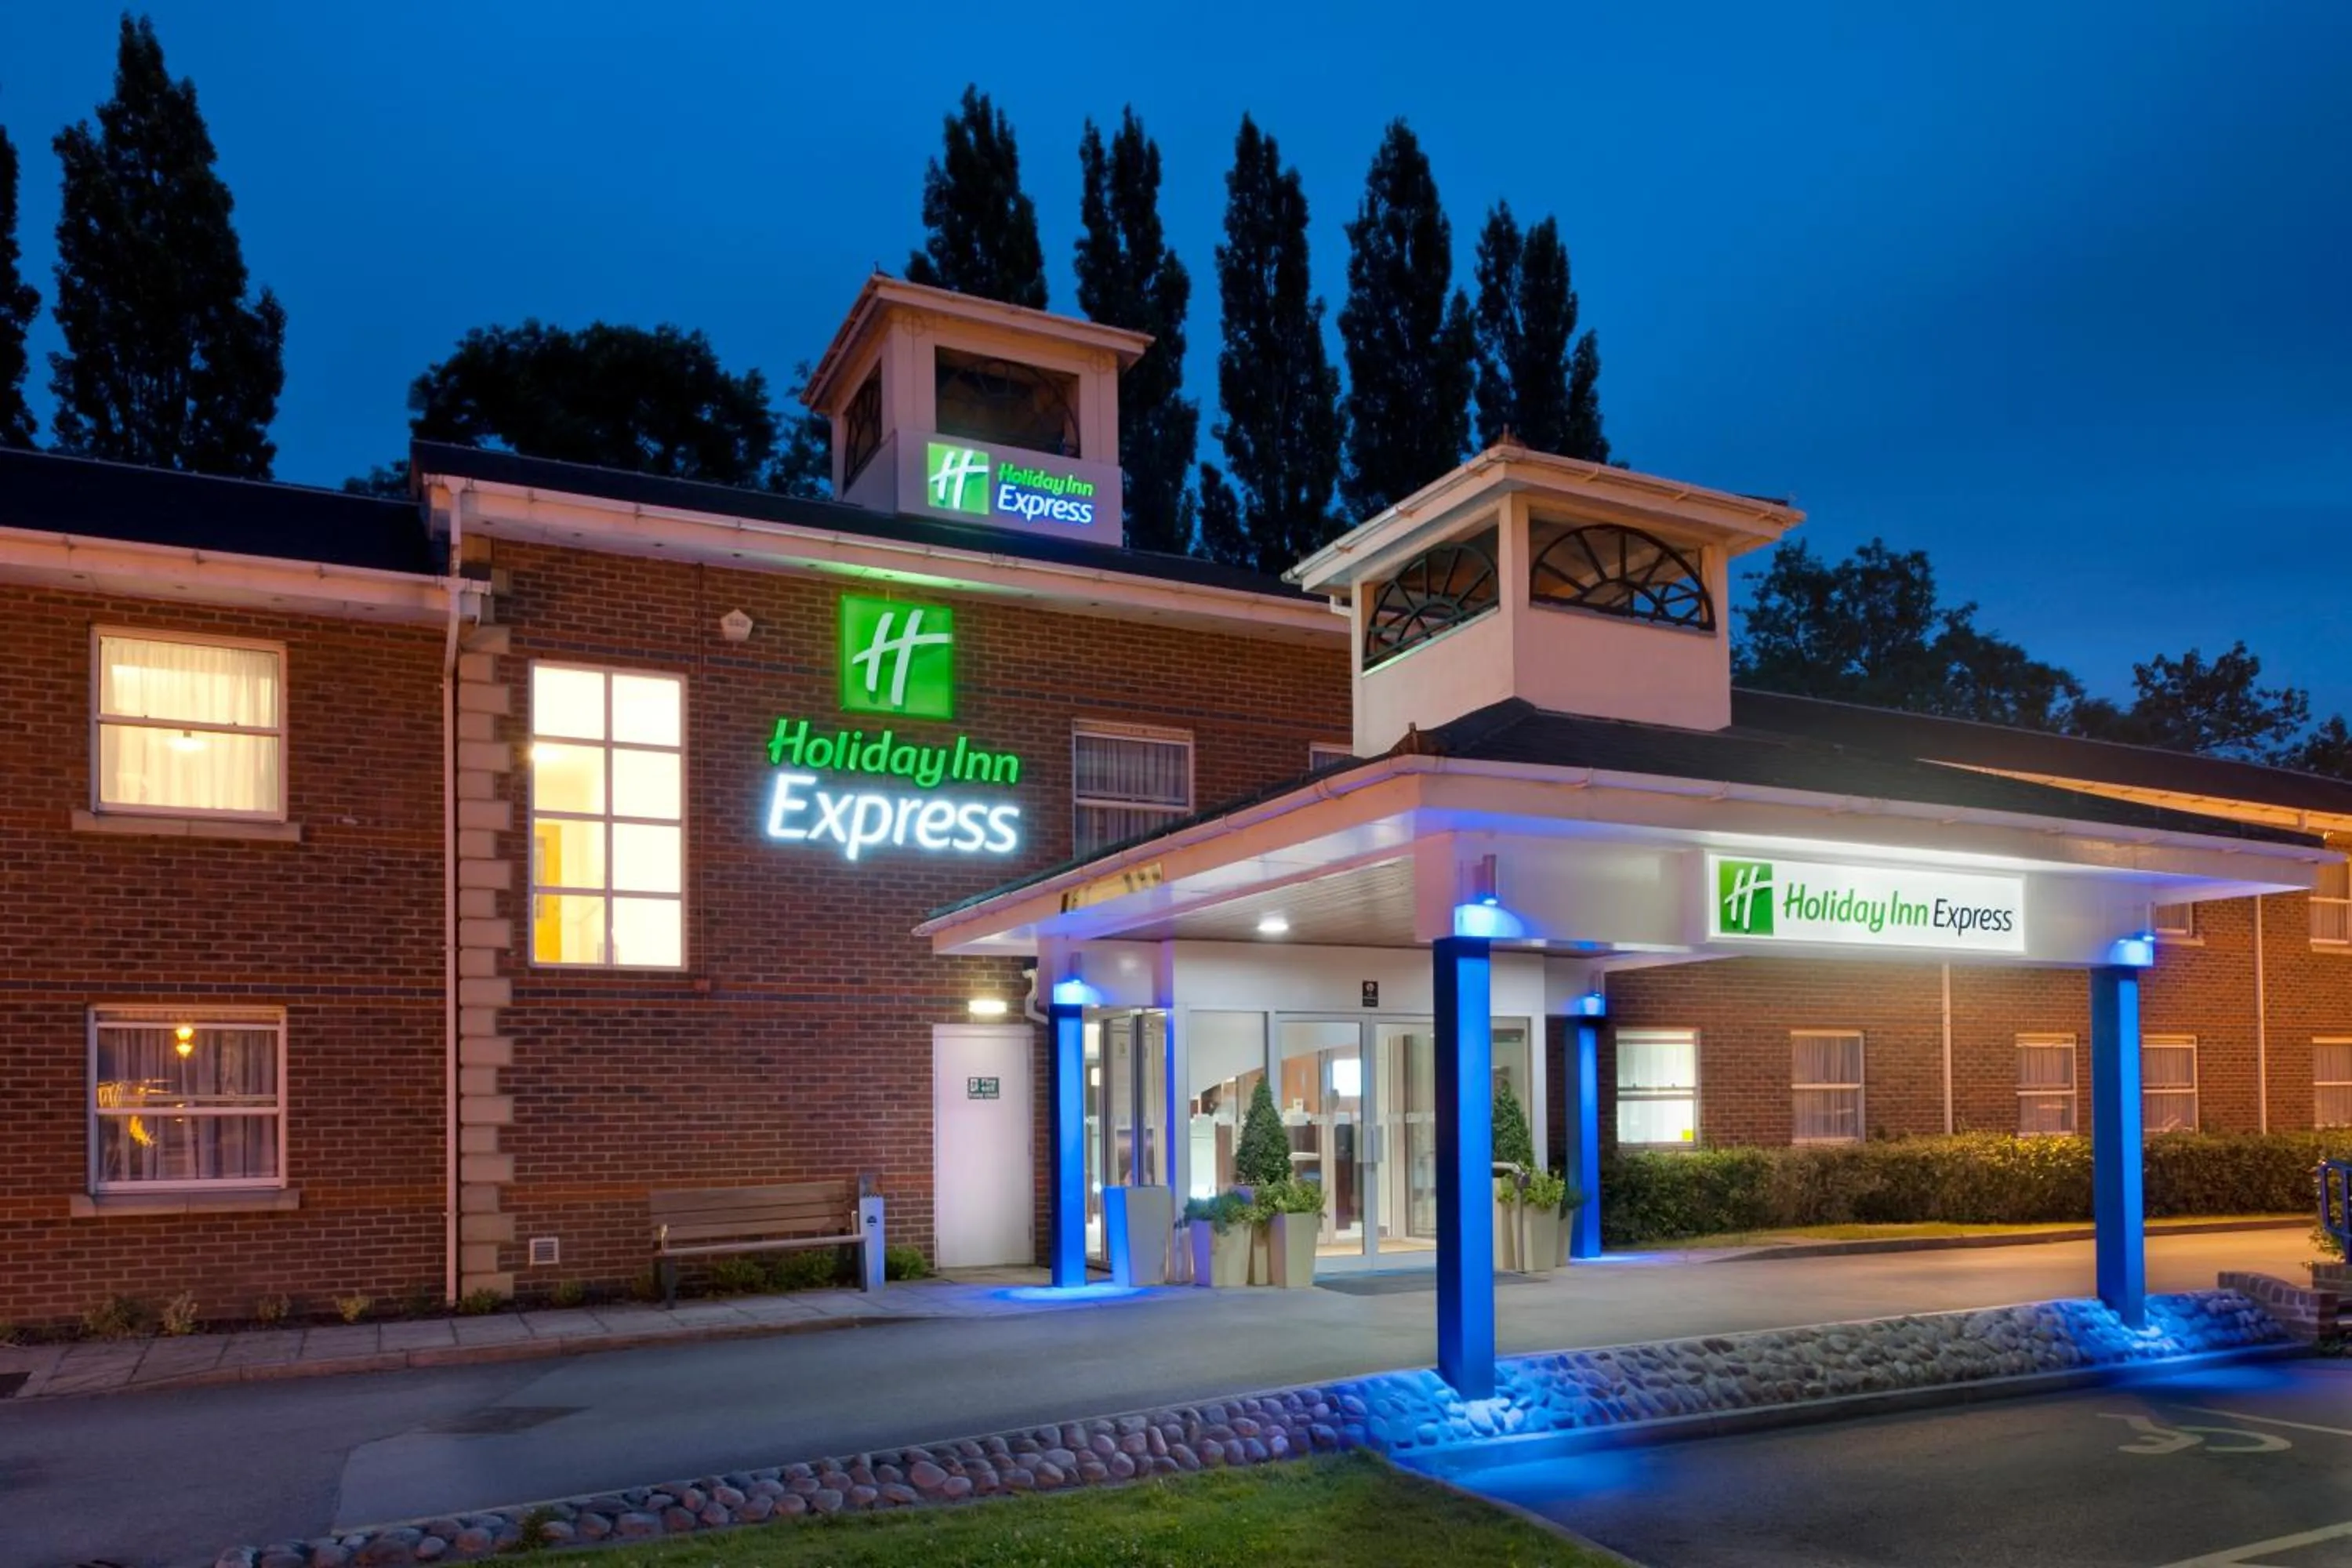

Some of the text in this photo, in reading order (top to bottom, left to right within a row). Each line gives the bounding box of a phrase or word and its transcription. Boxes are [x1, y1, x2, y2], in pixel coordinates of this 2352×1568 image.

[997, 484, 1094, 523] Express
[998, 463, 1094, 496] Holiday Inn
[767, 718, 1019, 787] Holiday Inn
[767, 771, 1021, 862] Express
[1783, 882, 2013, 937] Holiday Inn Express
